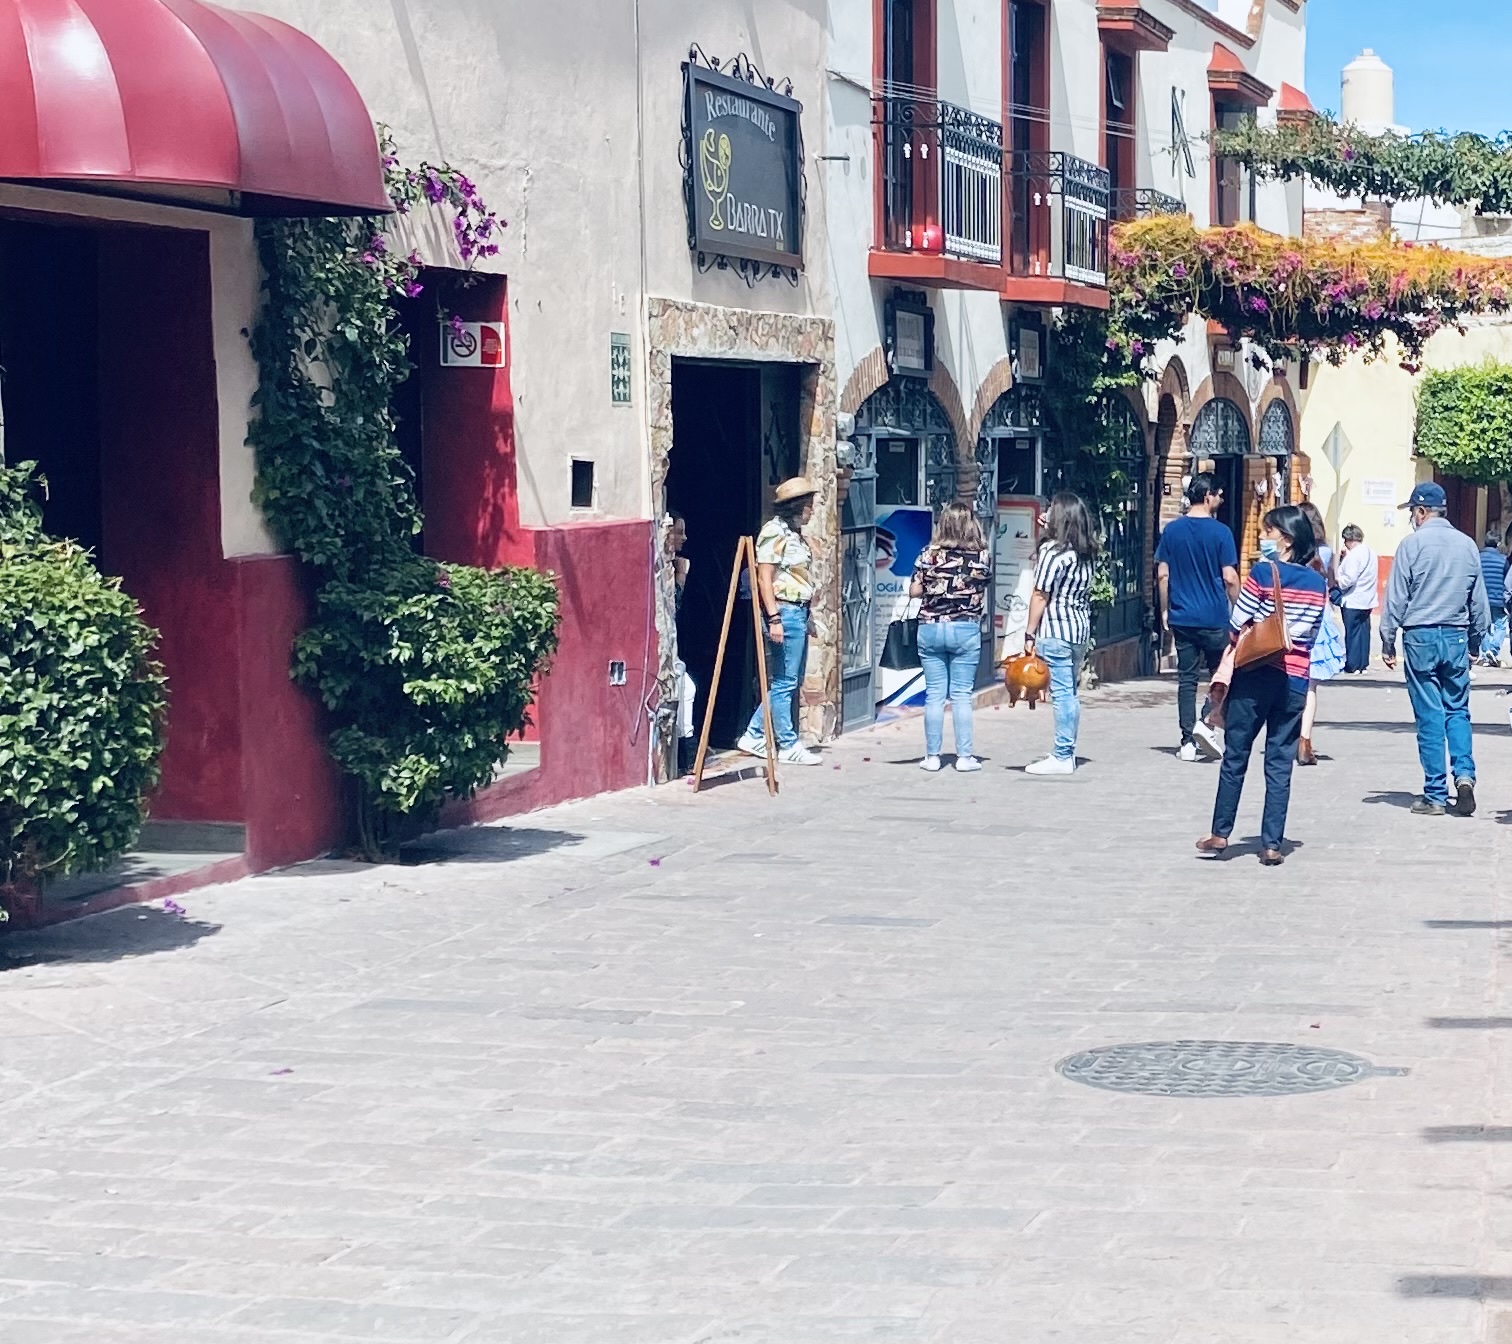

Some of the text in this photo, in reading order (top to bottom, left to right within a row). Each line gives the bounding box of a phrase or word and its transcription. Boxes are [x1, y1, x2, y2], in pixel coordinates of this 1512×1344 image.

[704, 90, 776, 142] Restaurante
[727, 192, 784, 241] BARRA TX
